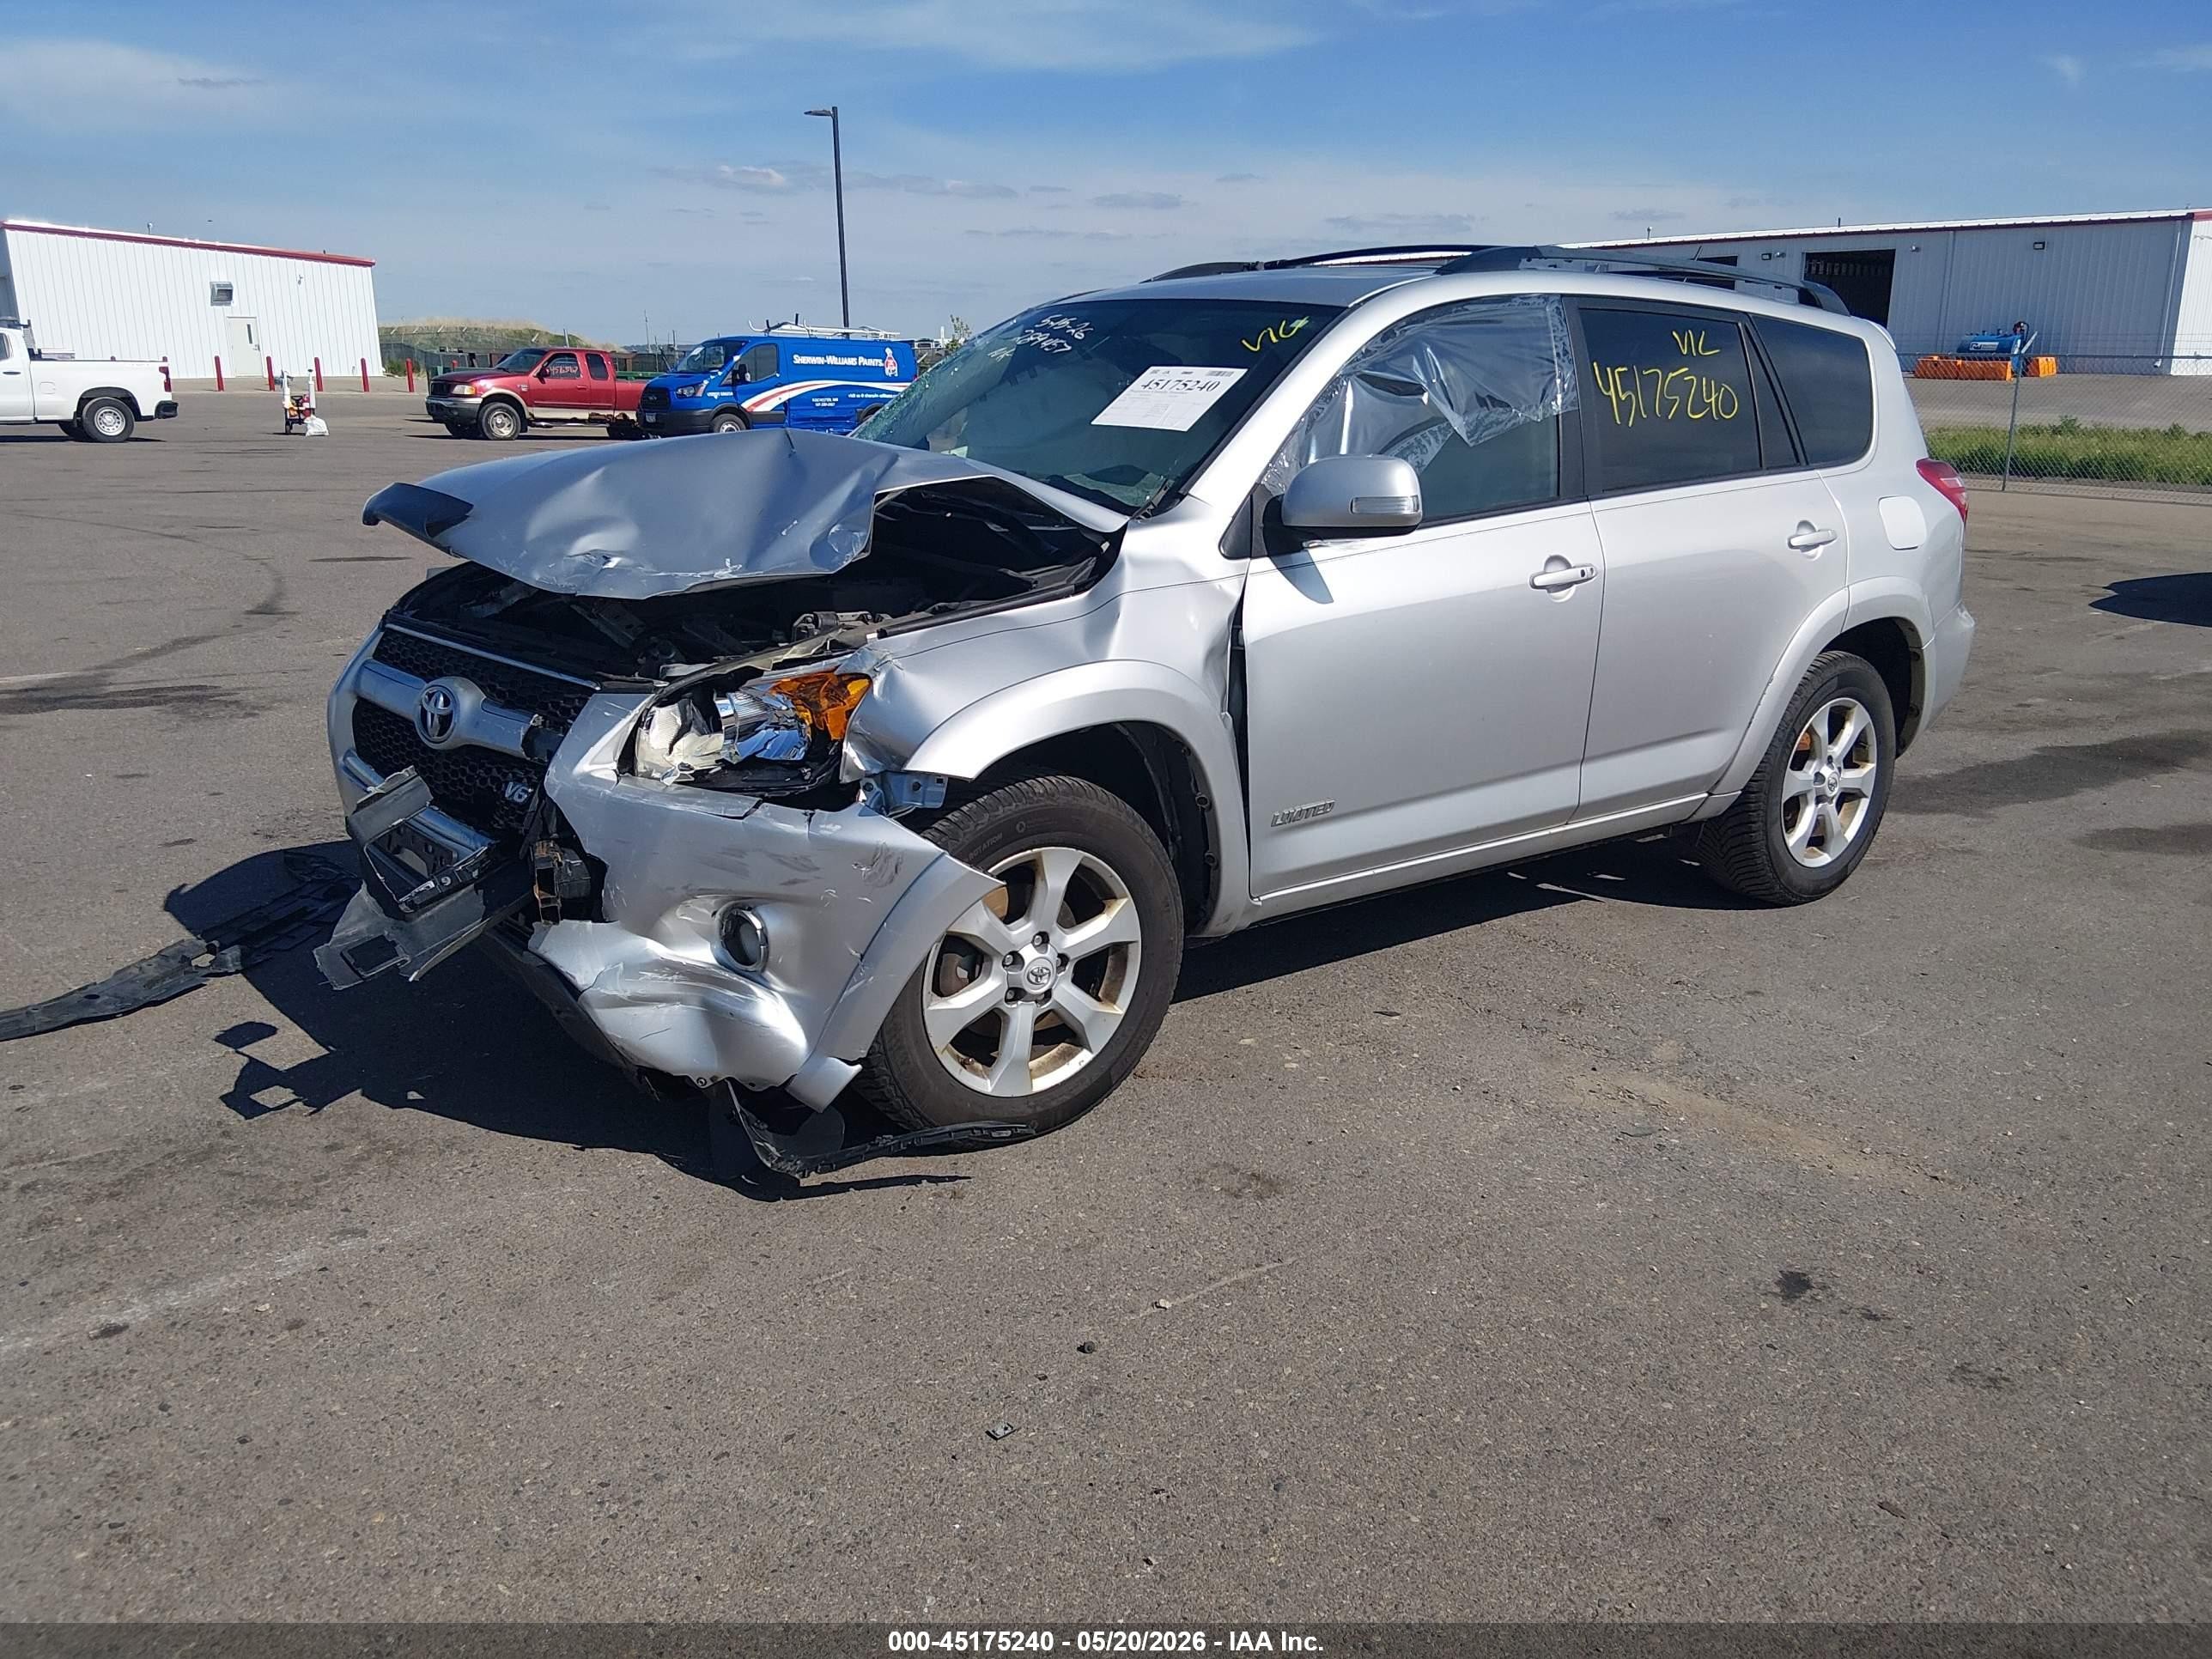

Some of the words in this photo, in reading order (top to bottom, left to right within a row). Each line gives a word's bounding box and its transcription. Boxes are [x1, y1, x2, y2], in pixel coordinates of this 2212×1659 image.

[1140, 378, 1221, 392] 45175240
[1593, 362, 1738, 428] 45175240
[504, 781, 530, 803] V6
[1270, 798, 1336, 827] LIMITED
